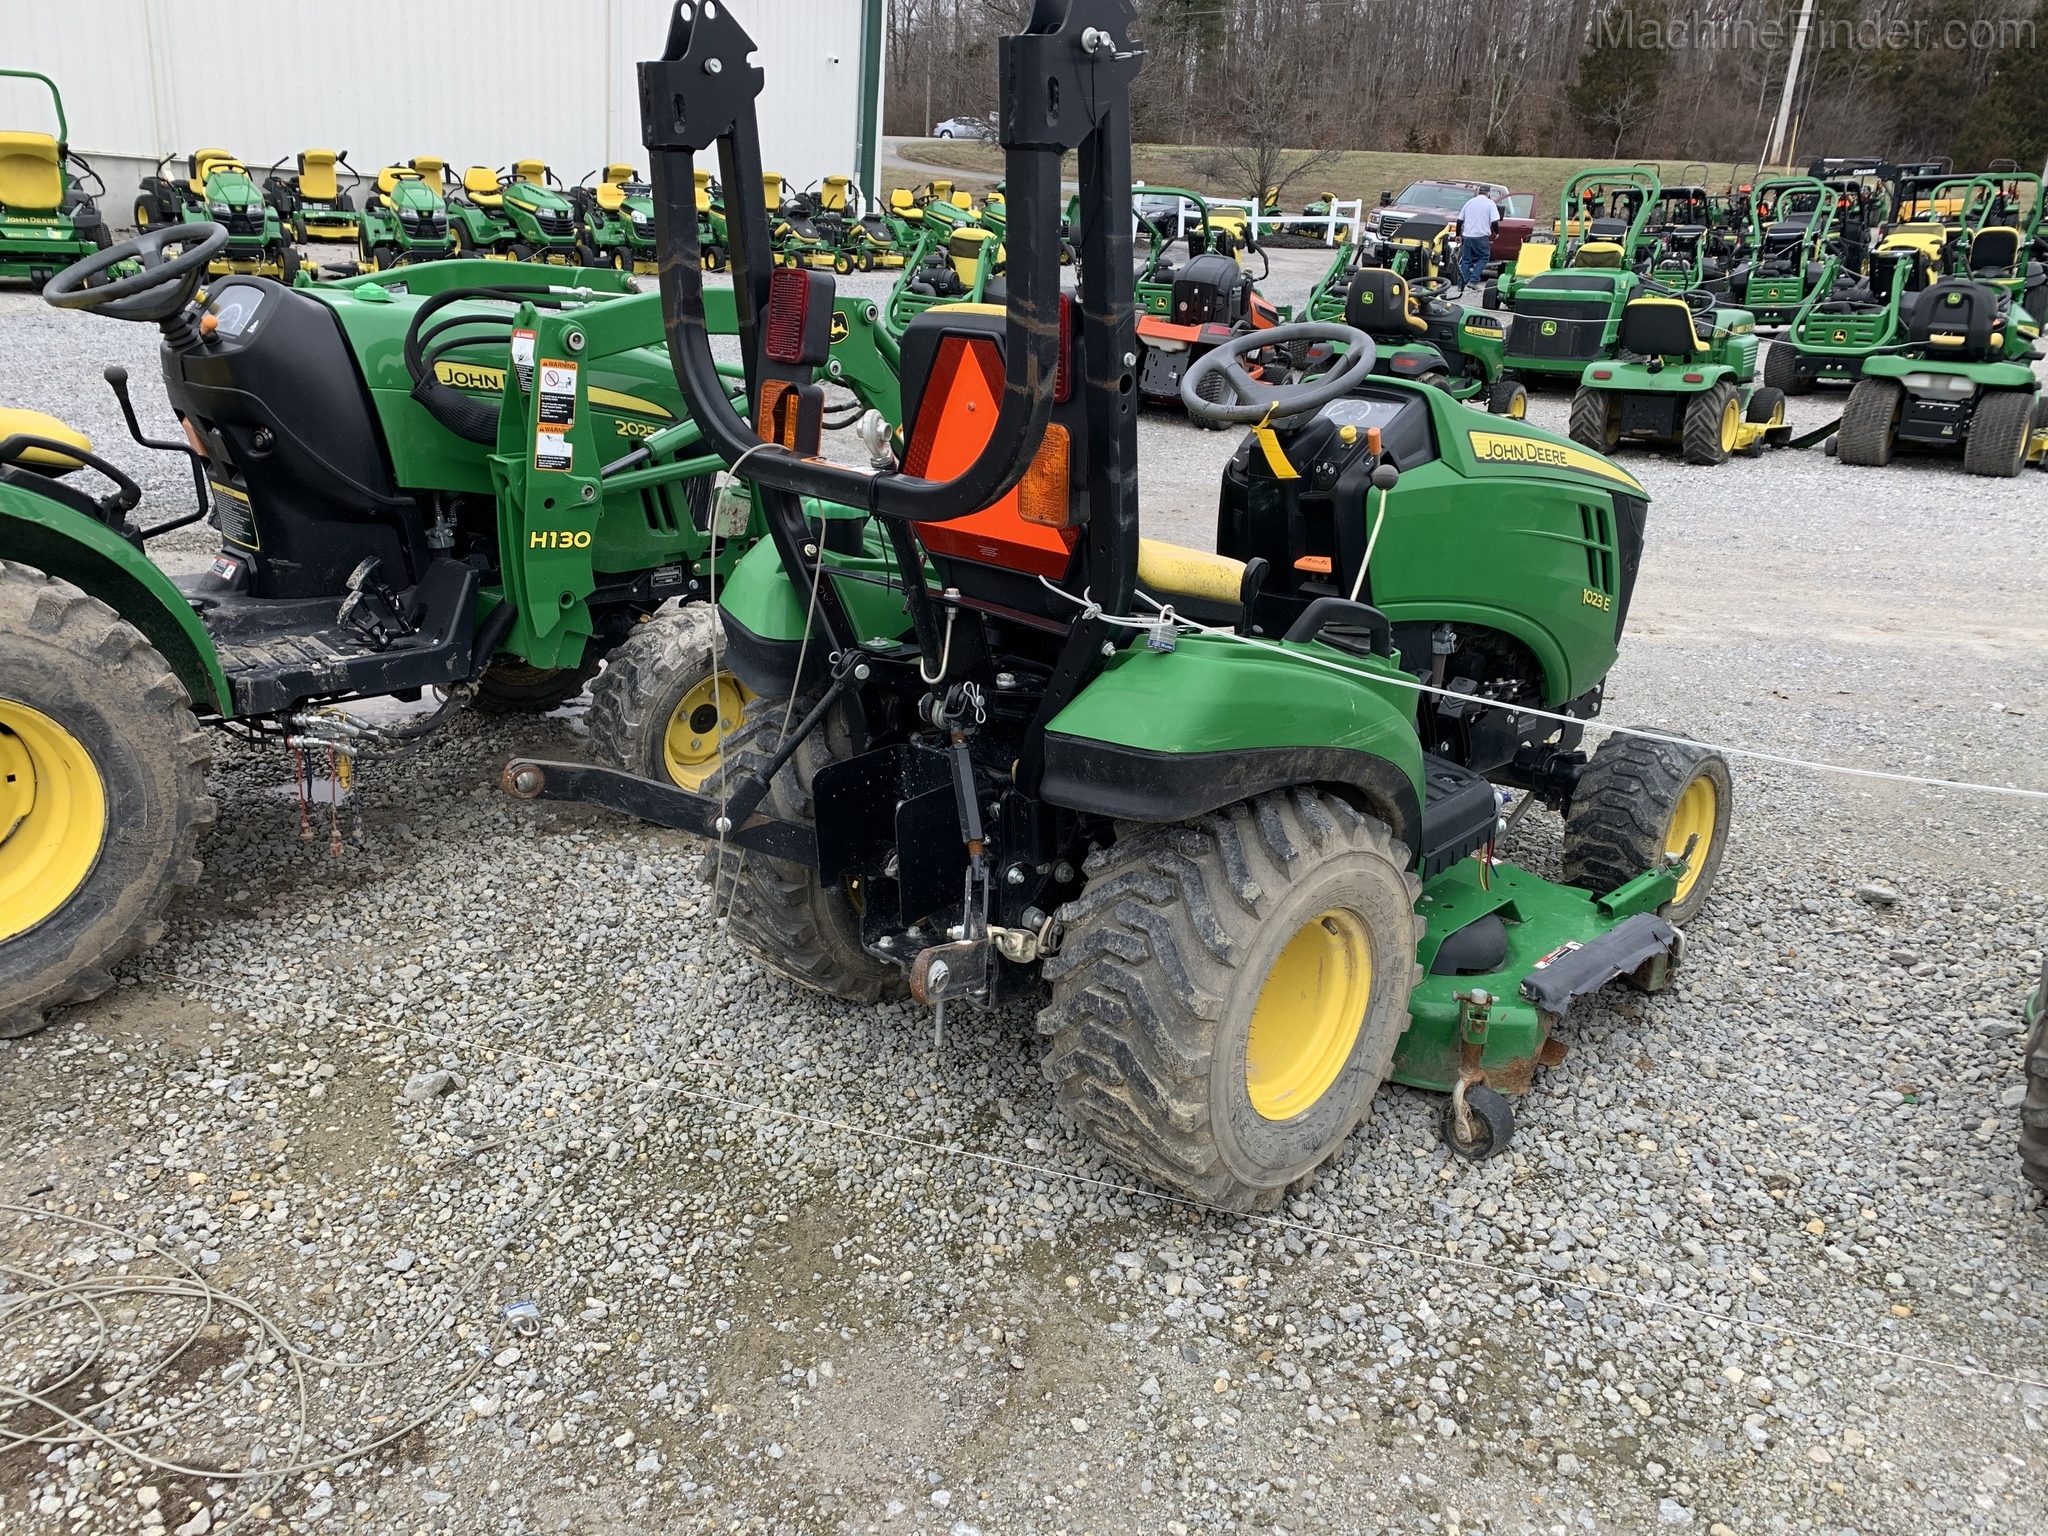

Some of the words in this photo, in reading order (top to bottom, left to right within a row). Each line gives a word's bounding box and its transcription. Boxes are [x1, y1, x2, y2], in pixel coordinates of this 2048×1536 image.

[30, 216, 59, 224] DEERE
[547, 361, 576, 370] WARNING
[442, 369, 496, 388] JOHN
[1485, 440, 1524, 459] JOHN
[1527, 443, 1568, 465] DEERE
[529, 530, 592, 549] H130
[1582, 588, 1604, 608] 1023
